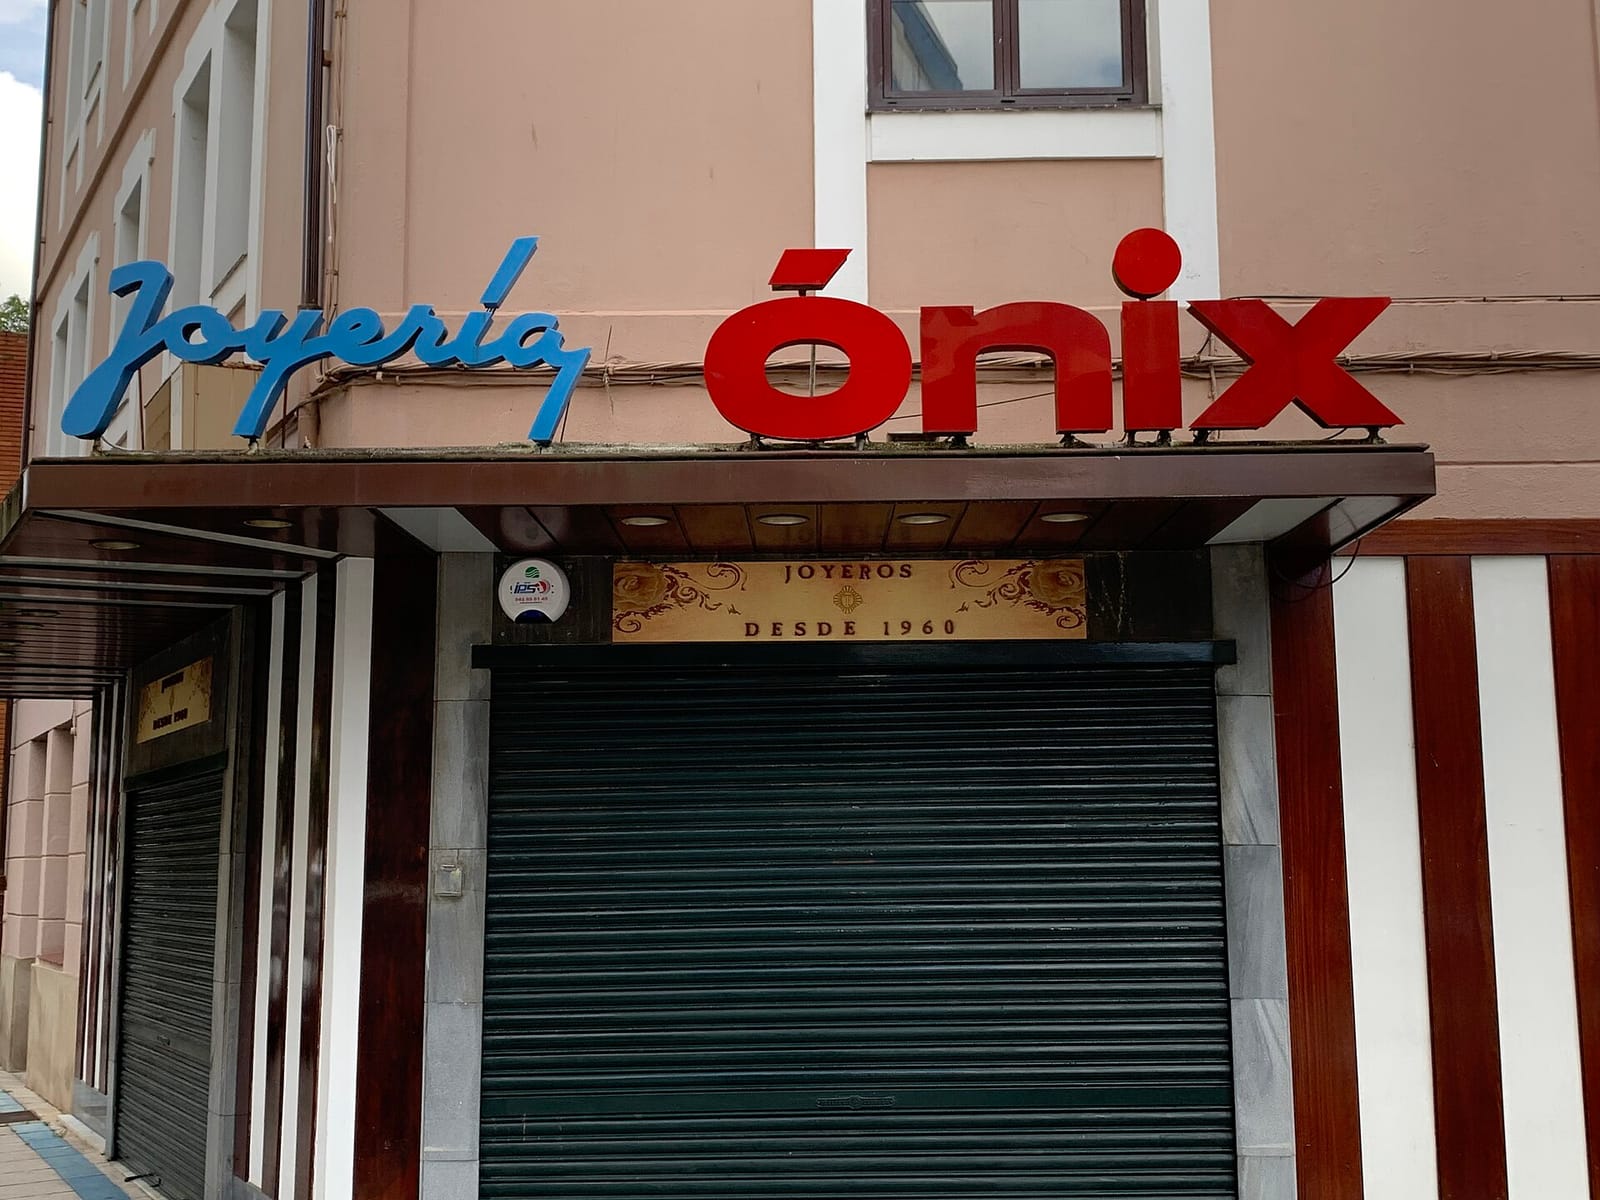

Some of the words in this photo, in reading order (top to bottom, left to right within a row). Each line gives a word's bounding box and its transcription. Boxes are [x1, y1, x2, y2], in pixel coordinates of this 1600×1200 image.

[61, 236, 592, 442] Joyería
[703, 227, 1406, 442] ónix
[784, 563, 913, 584] JOYEROS
[744, 621, 857, 637] DESDE
[883, 619, 955, 637] 1960
